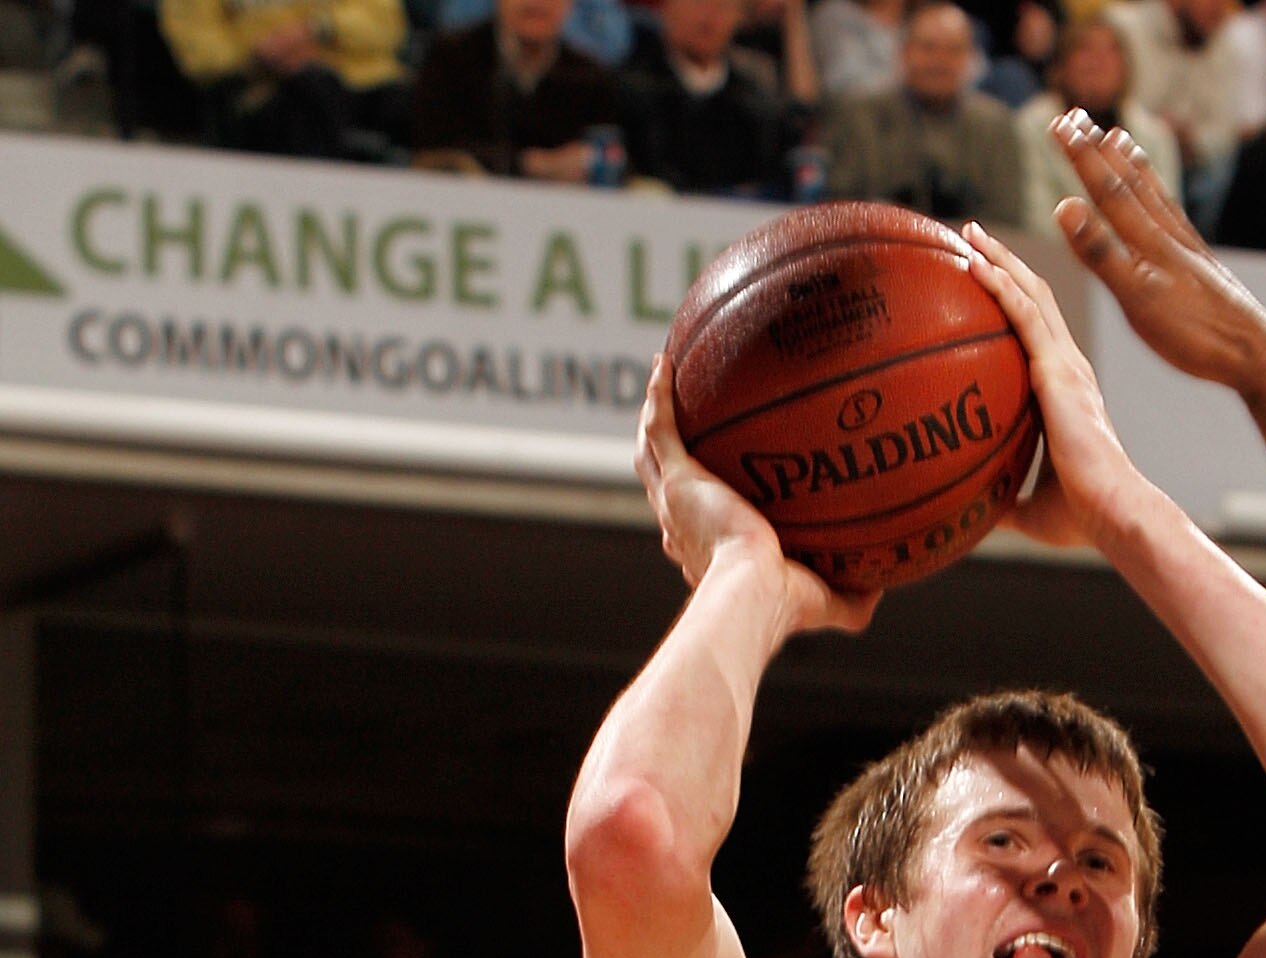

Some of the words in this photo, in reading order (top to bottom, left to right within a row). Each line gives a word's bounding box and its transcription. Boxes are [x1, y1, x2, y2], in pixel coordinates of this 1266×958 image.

[68, 186, 500, 308] CHANGE
[531, 229, 594, 318] A
[626, 234, 722, 324] LI
[740, 380, 994, 502] SPALDING
